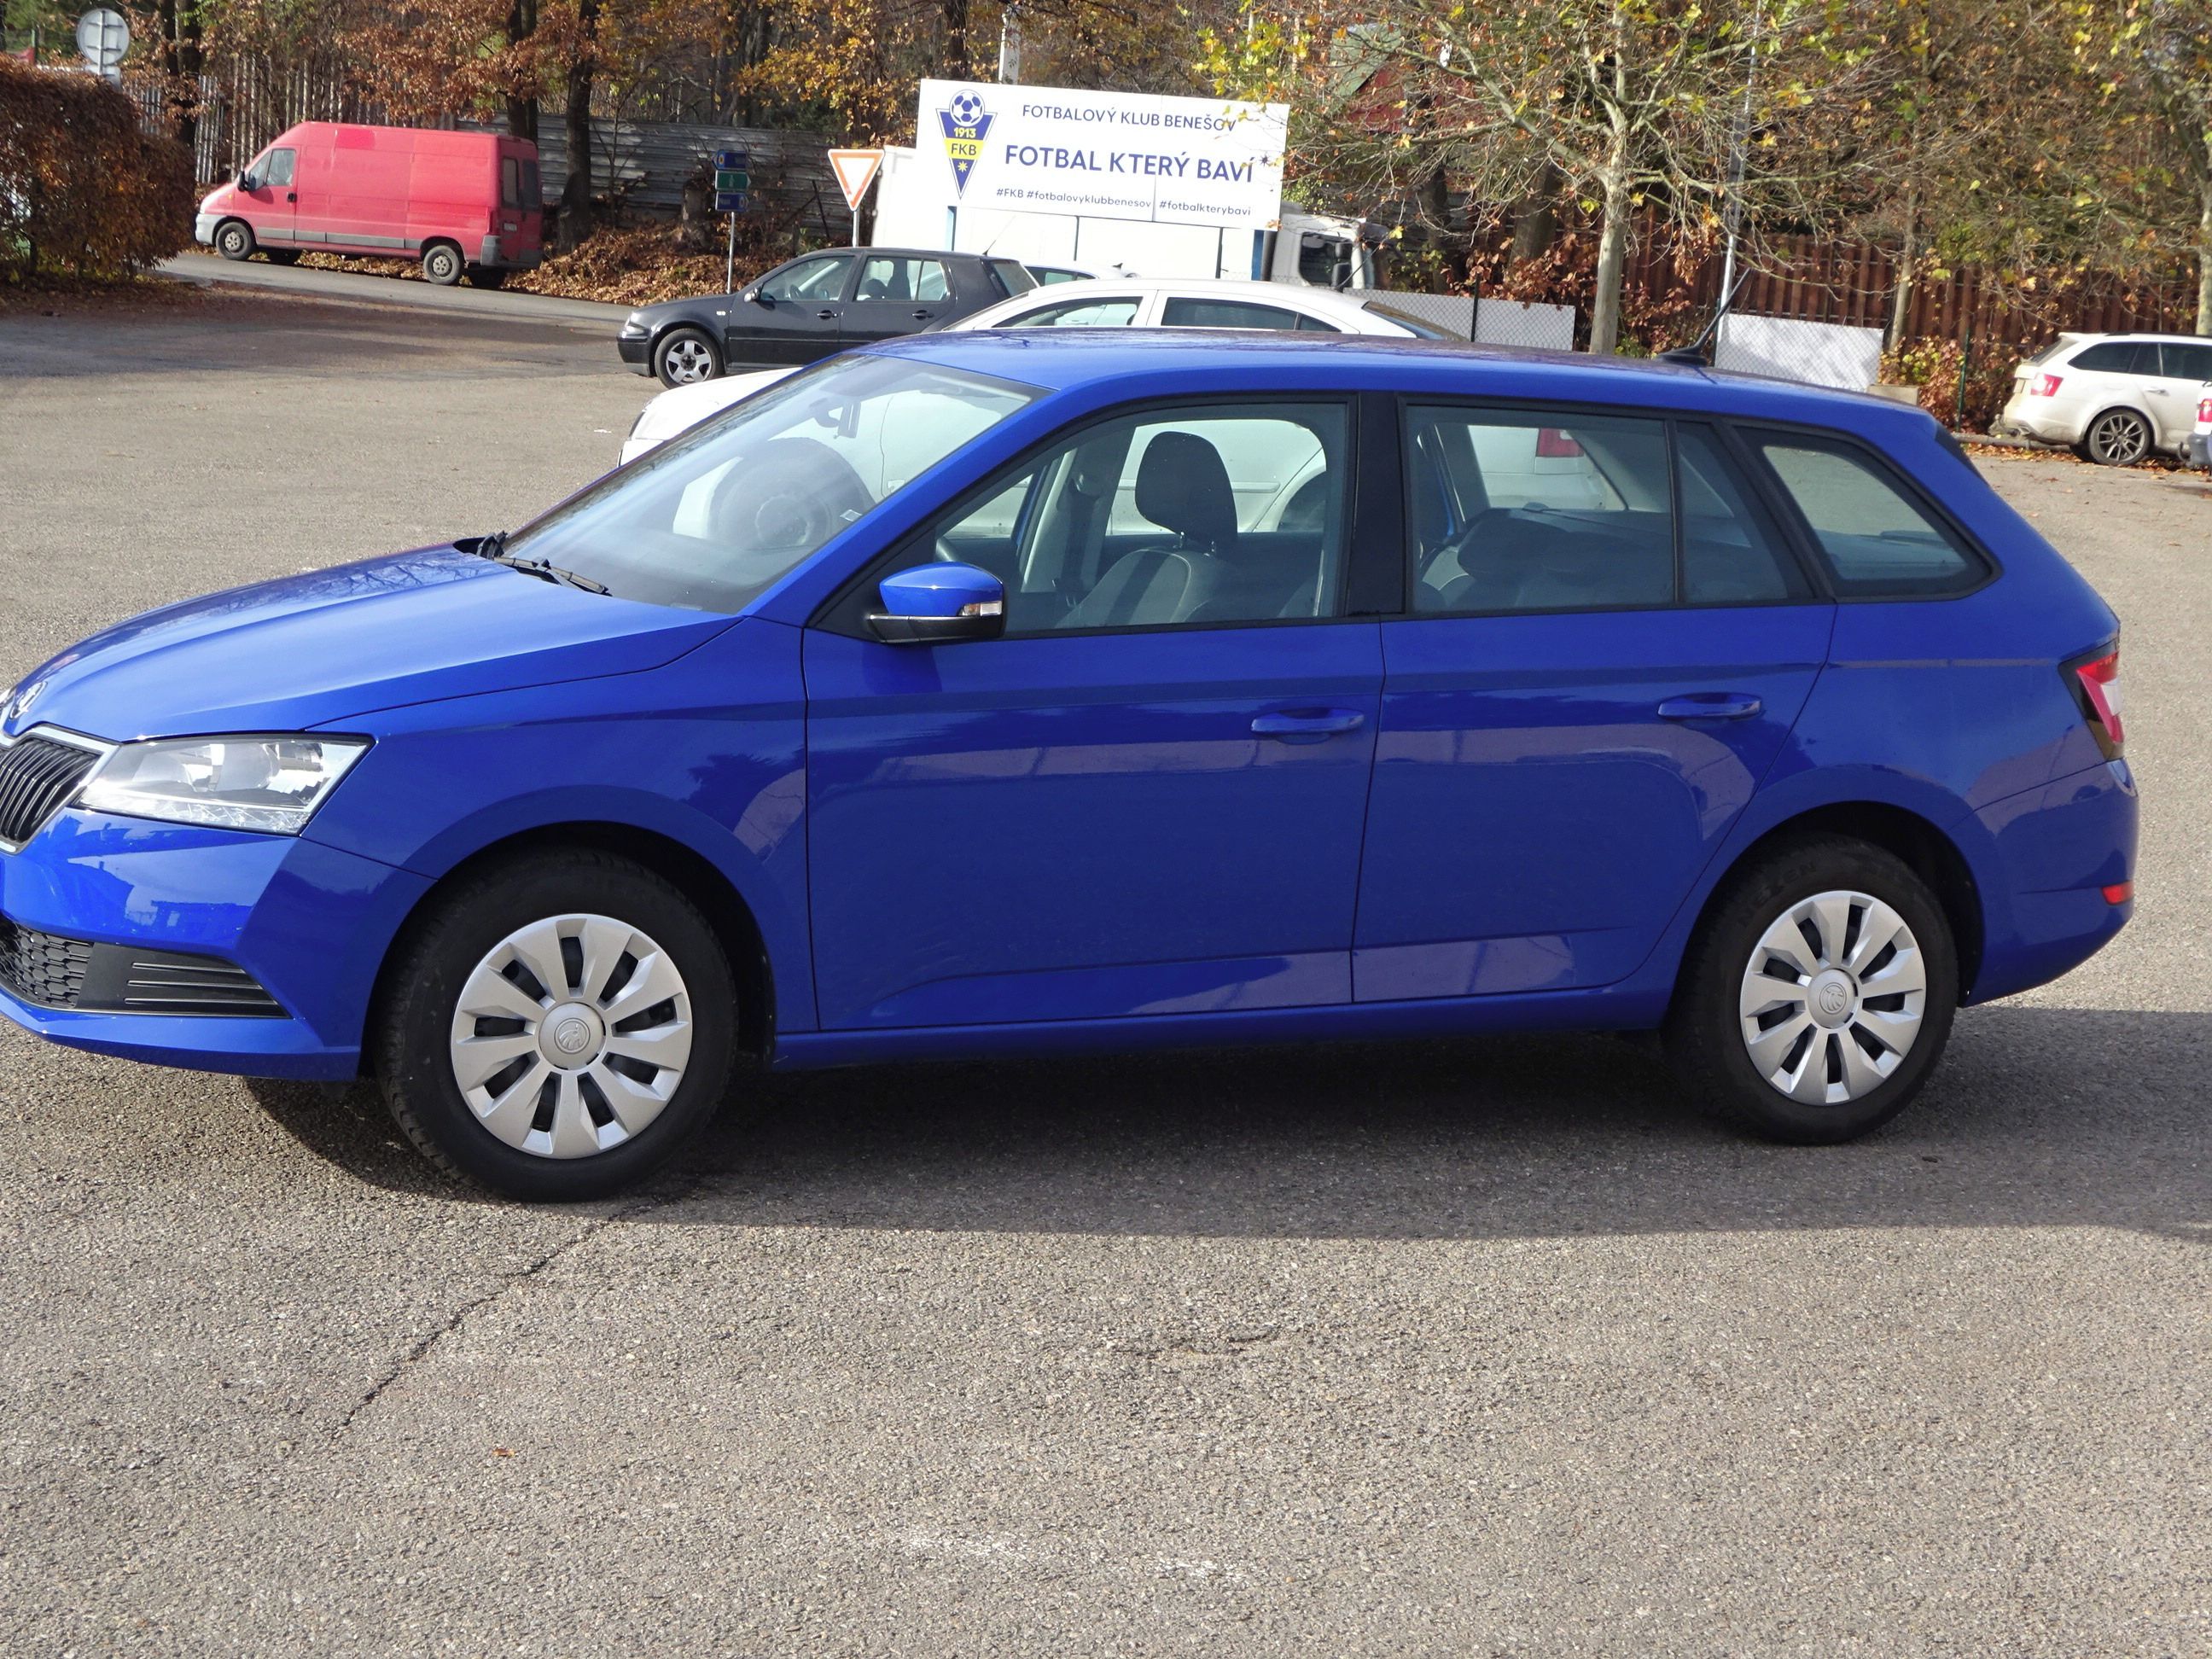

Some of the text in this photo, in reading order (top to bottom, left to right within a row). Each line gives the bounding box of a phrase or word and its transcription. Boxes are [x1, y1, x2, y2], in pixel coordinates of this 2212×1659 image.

[1022, 104, 1237, 131] FOTBALOVÝ KLUB BENEŠOV
[953, 126, 977, 138] 1913
[951, 143, 977, 156] FKB
[1005, 145, 1255, 183] FOTBAL KTERÝ BAVÍ
[996, 188, 1252, 216] #FKB #fotbalovyklubbenesov #fotbalkterybavi
